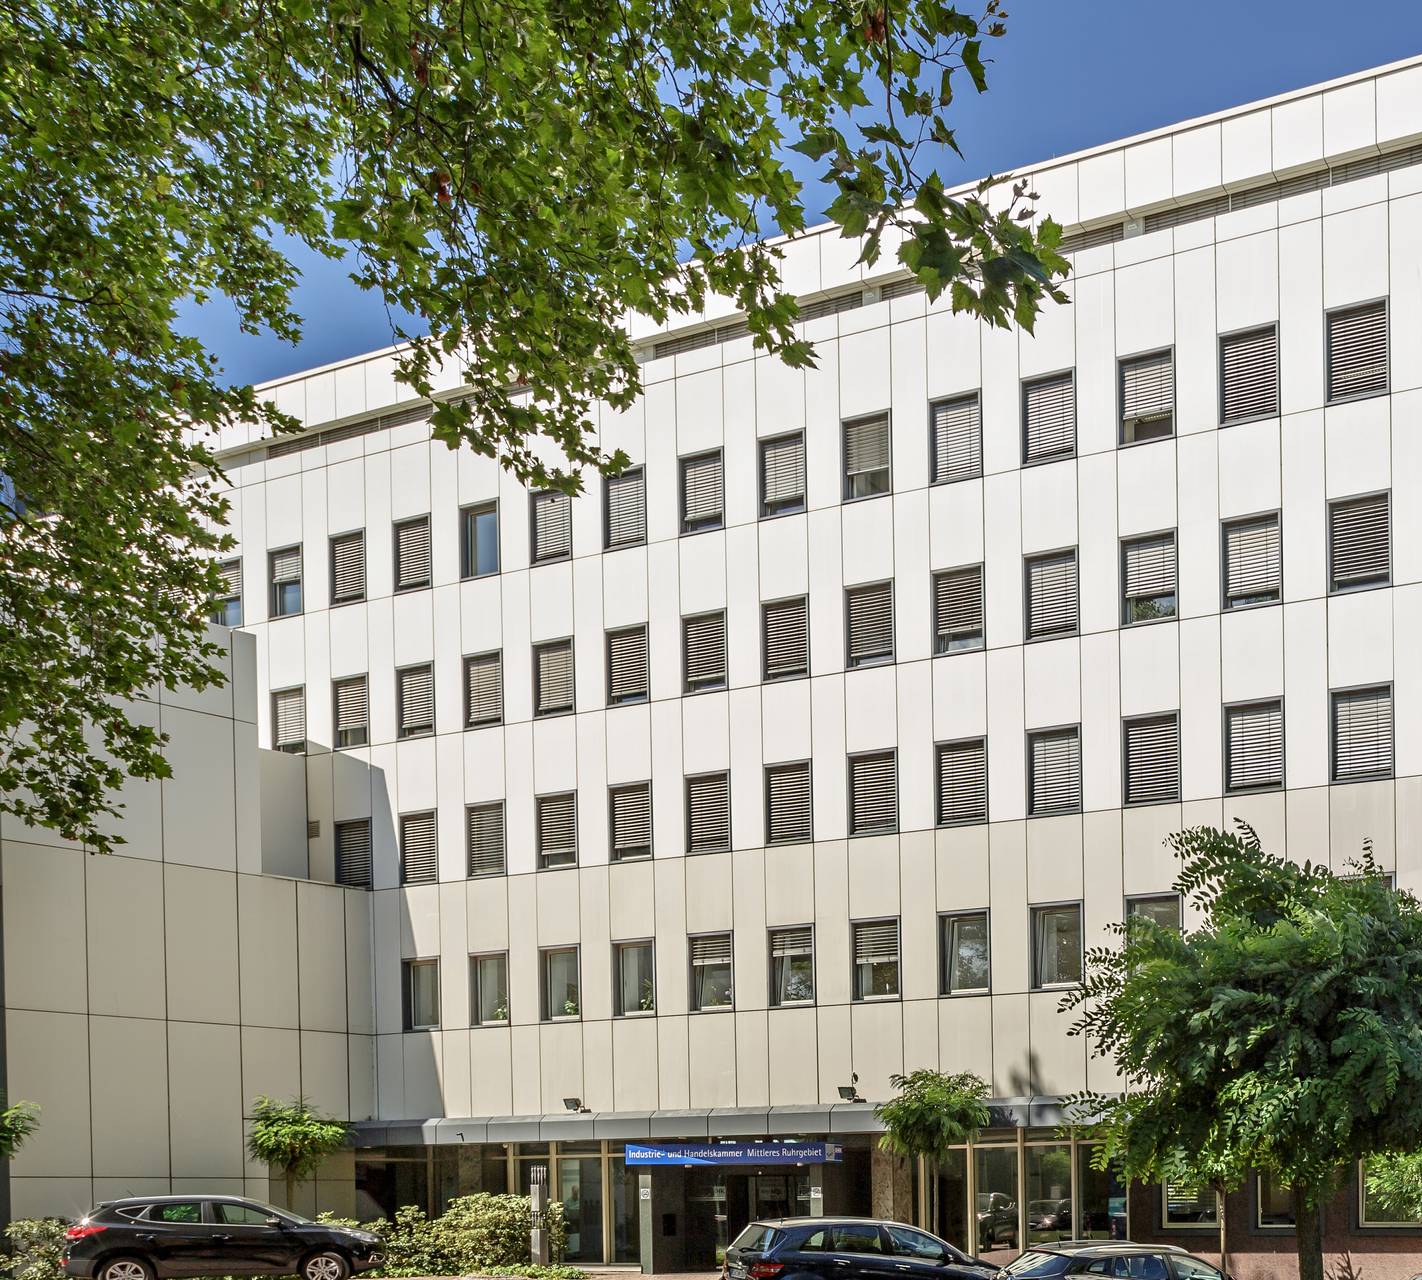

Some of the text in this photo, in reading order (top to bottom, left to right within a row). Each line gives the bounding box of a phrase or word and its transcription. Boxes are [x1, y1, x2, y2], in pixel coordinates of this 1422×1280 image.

[628, 1147, 822, 1159] Industrie- und Handelskammer Mittleres Ruhrgebiet
